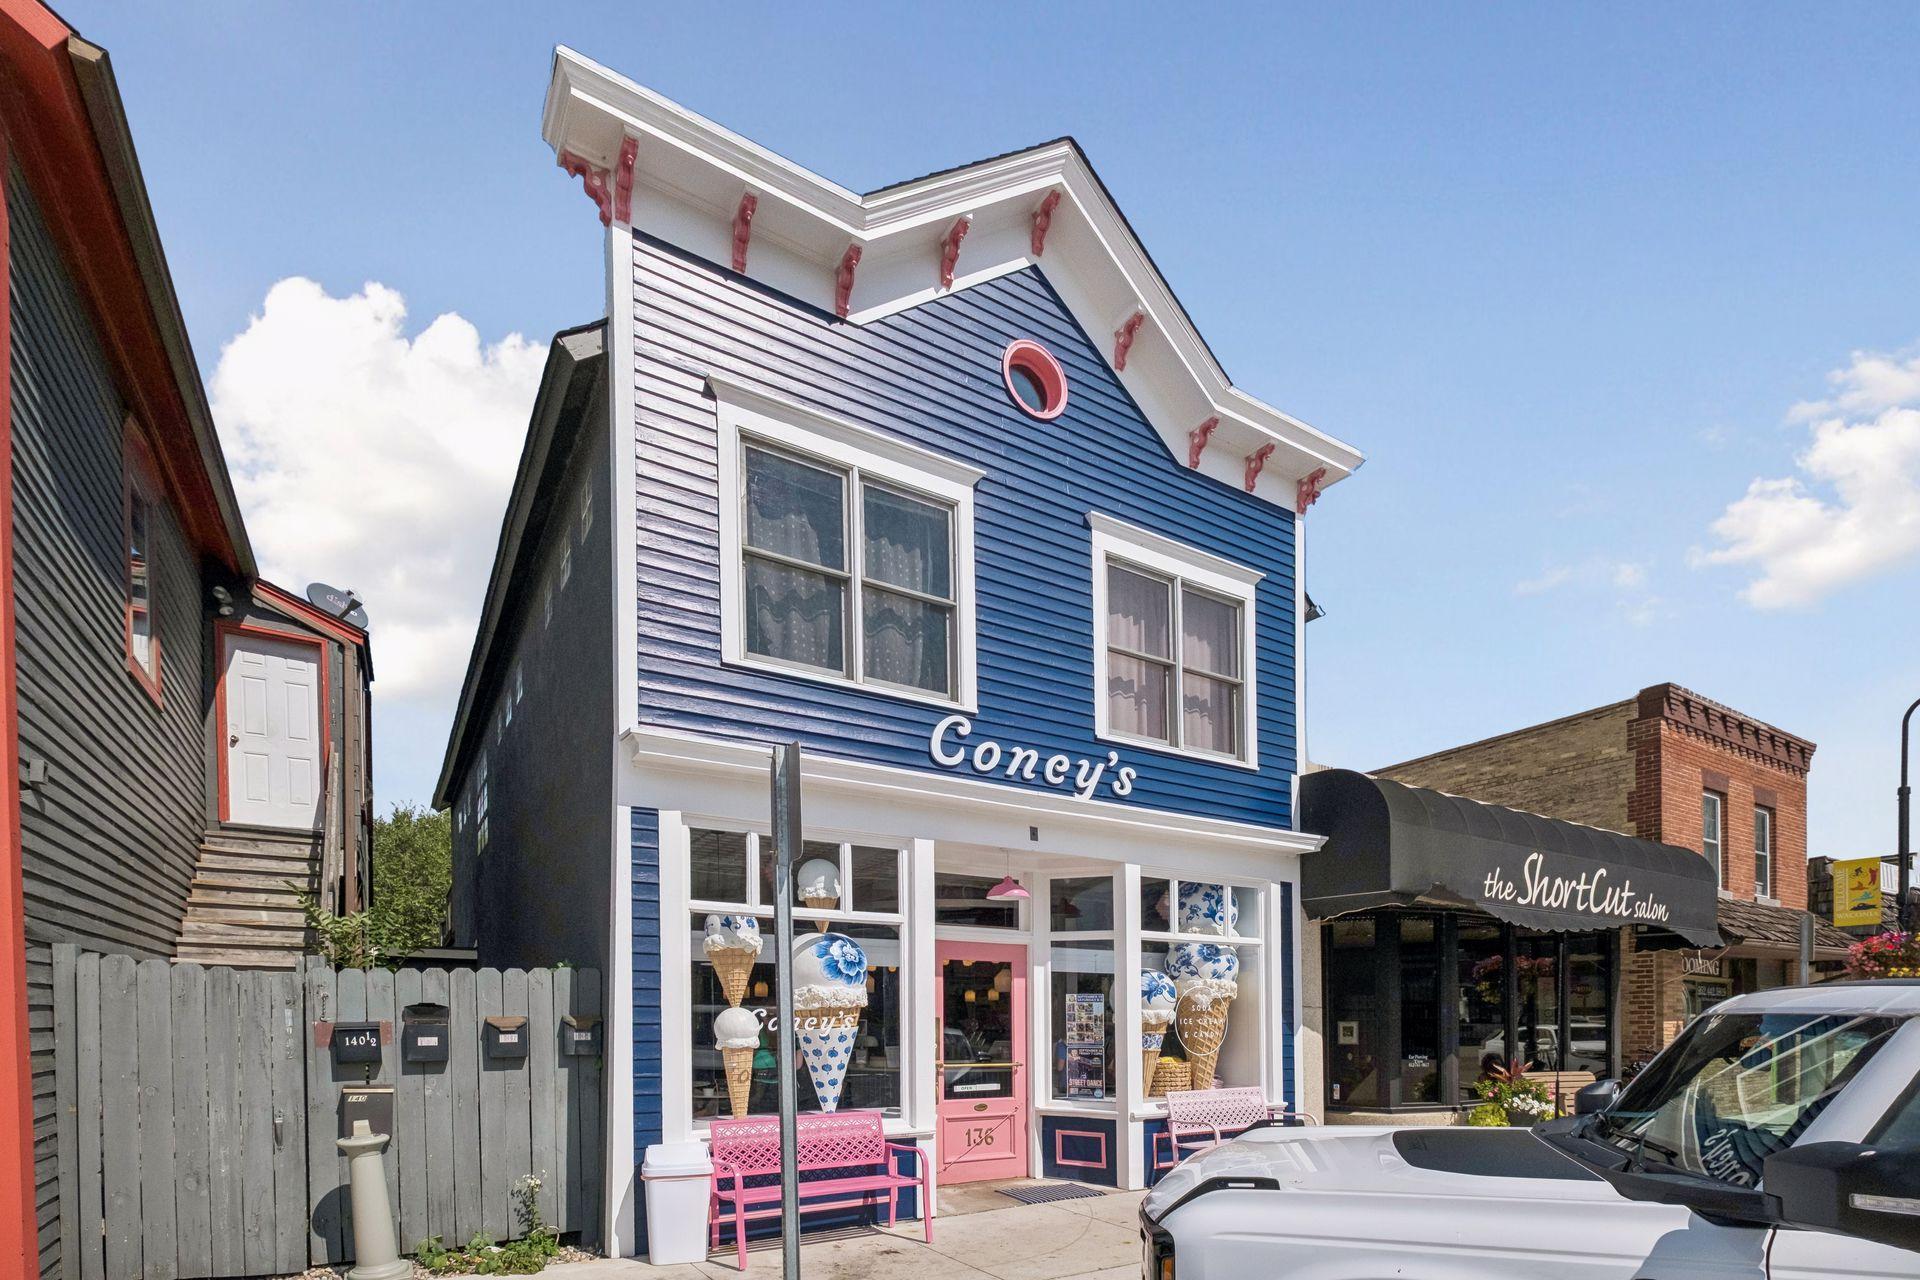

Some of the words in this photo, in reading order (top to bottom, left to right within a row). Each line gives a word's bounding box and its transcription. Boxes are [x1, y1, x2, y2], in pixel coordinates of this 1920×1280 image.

[929, 715, 1137, 800] Coney's
[1484, 867, 1517, 901] the
[1634, 893, 1669, 922] salon
[965, 1127, 994, 1147] 136
